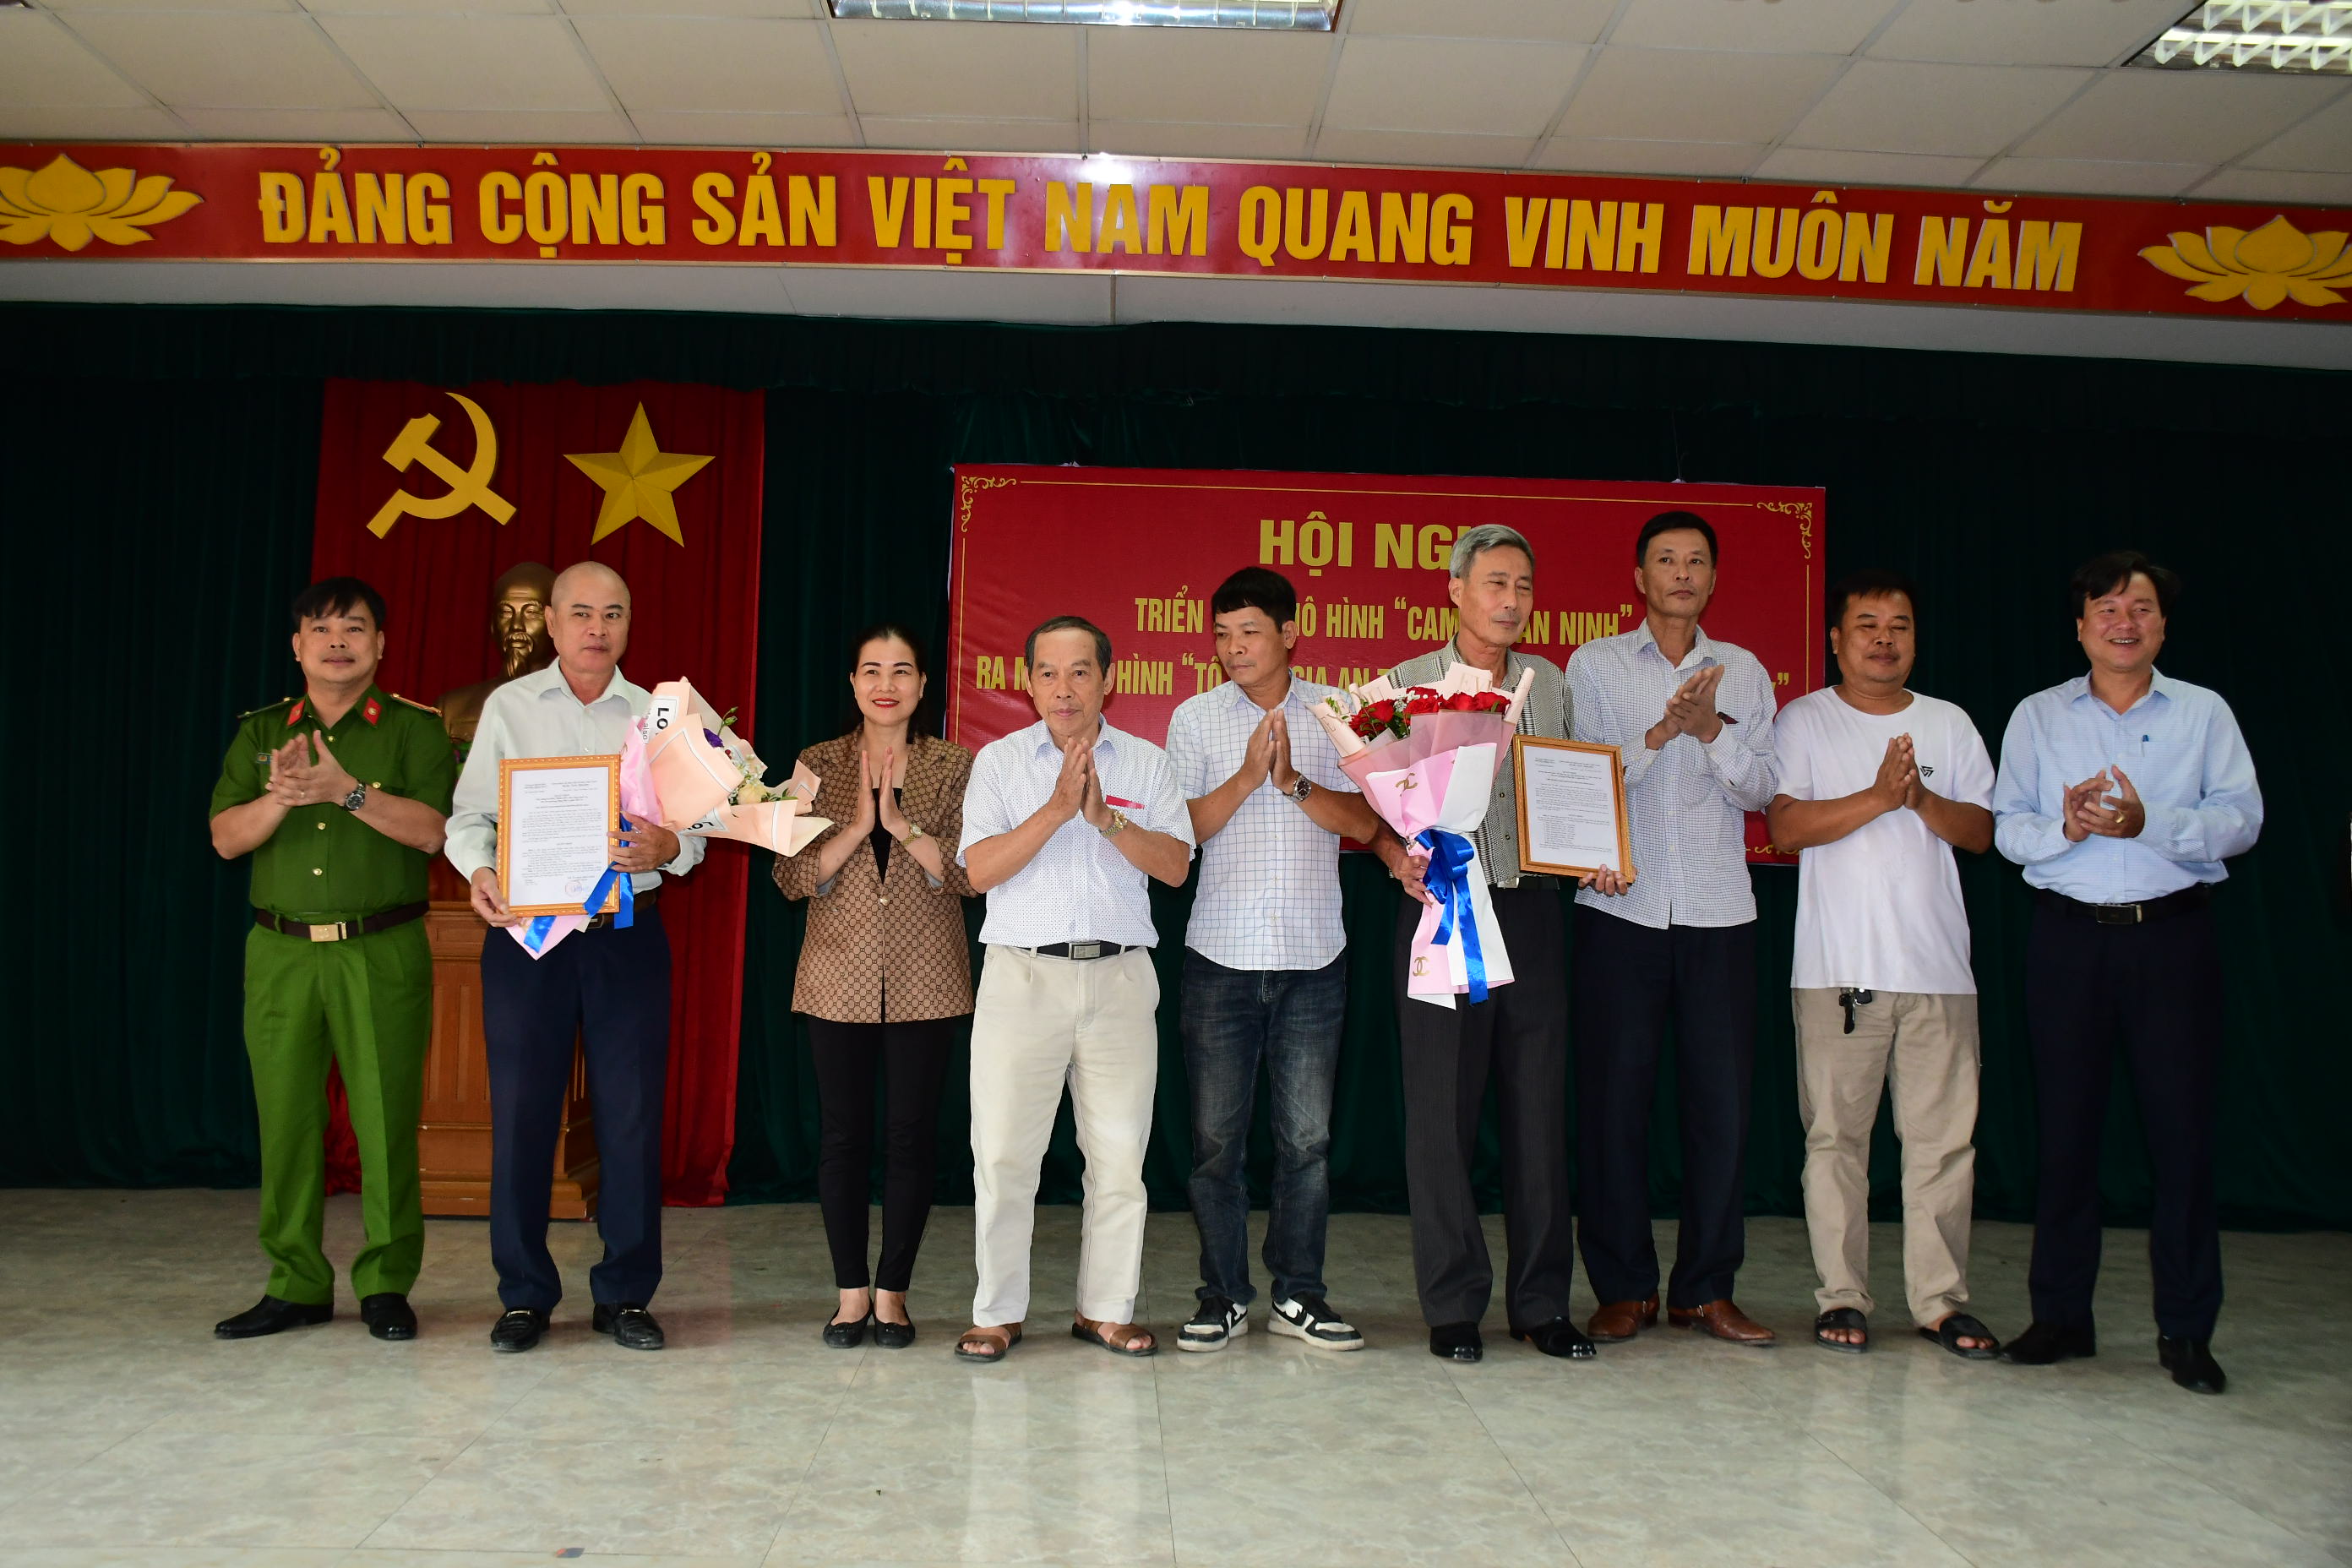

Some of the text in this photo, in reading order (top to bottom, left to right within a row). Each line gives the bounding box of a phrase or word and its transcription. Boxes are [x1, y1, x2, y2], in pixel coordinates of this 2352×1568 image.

[259, 144, 2083, 291] ĐẢNG CỘNG SẢN VIỆT NAM QUANG VINH MUÔN NĂM
[1259, 511, 1472, 577] HỘI NG
[1135, 585, 1204, 634] TRIỂN
[1326, 596, 1384, 640] HÌNH
[977, 656, 1006, 690] RA
[1116, 653, 1173, 695] HÌNH
